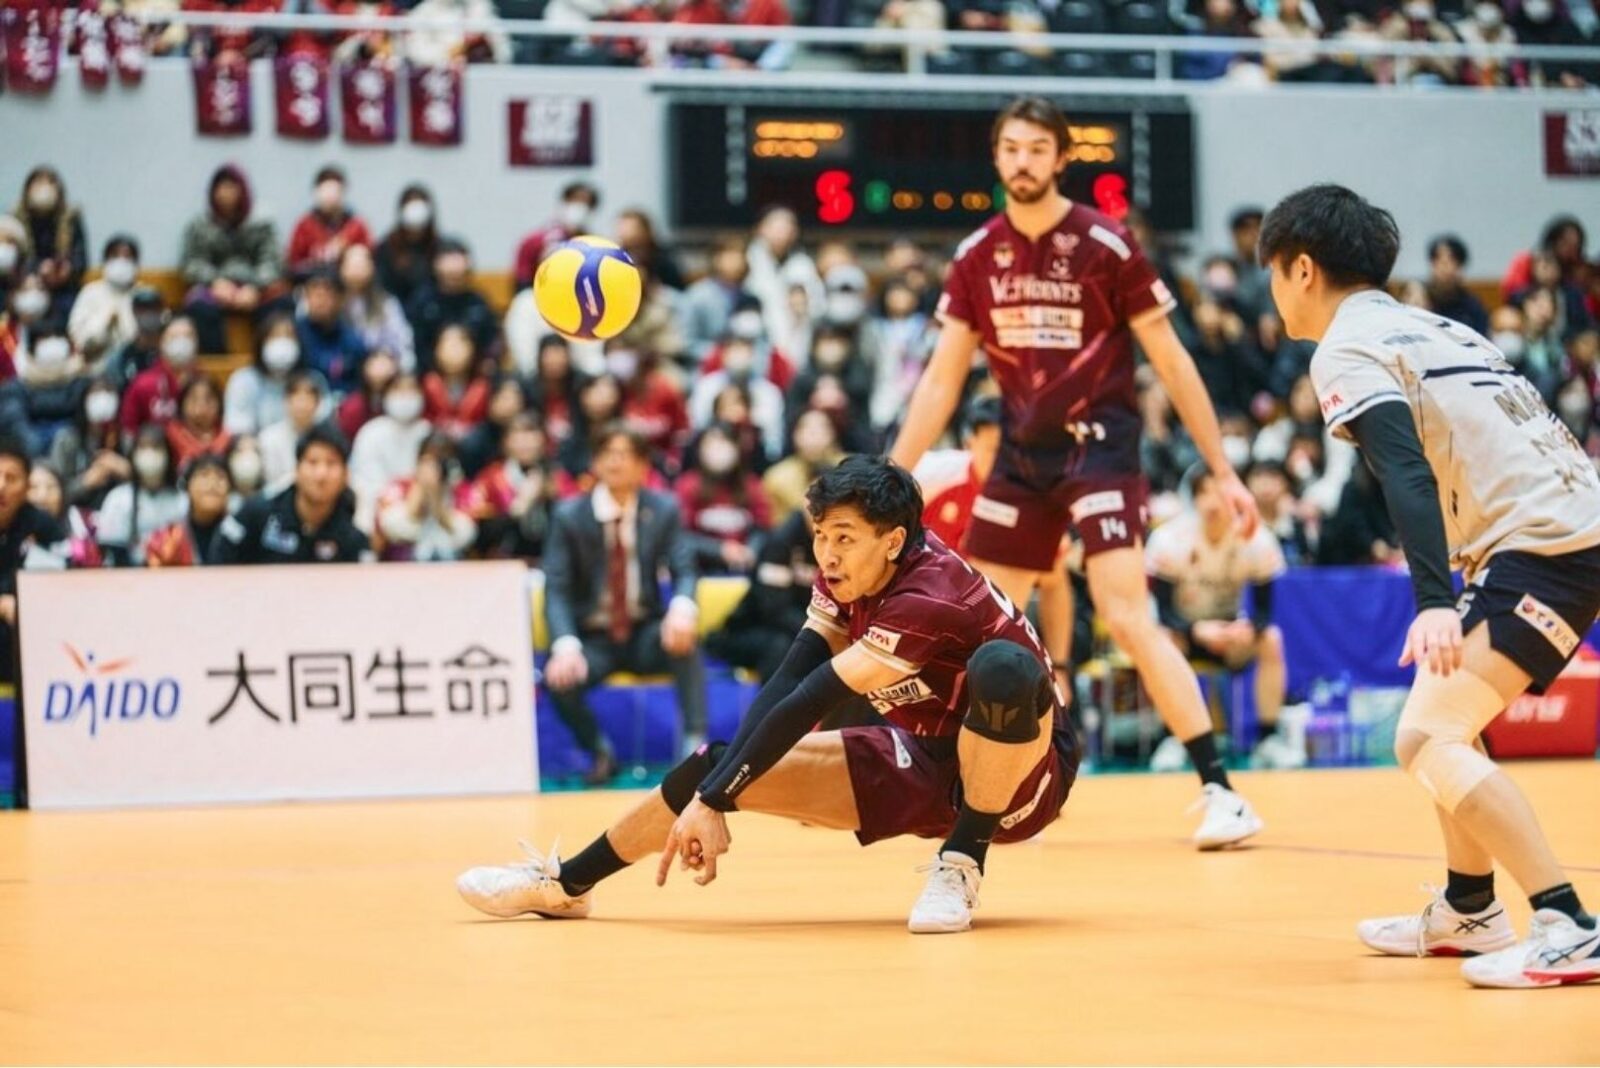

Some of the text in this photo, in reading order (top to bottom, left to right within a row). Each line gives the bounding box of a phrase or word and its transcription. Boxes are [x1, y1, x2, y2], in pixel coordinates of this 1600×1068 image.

[1099, 516, 1128, 542] 14
[44, 676, 182, 737] DAIDO
[204, 643, 513, 727] 大同生命
